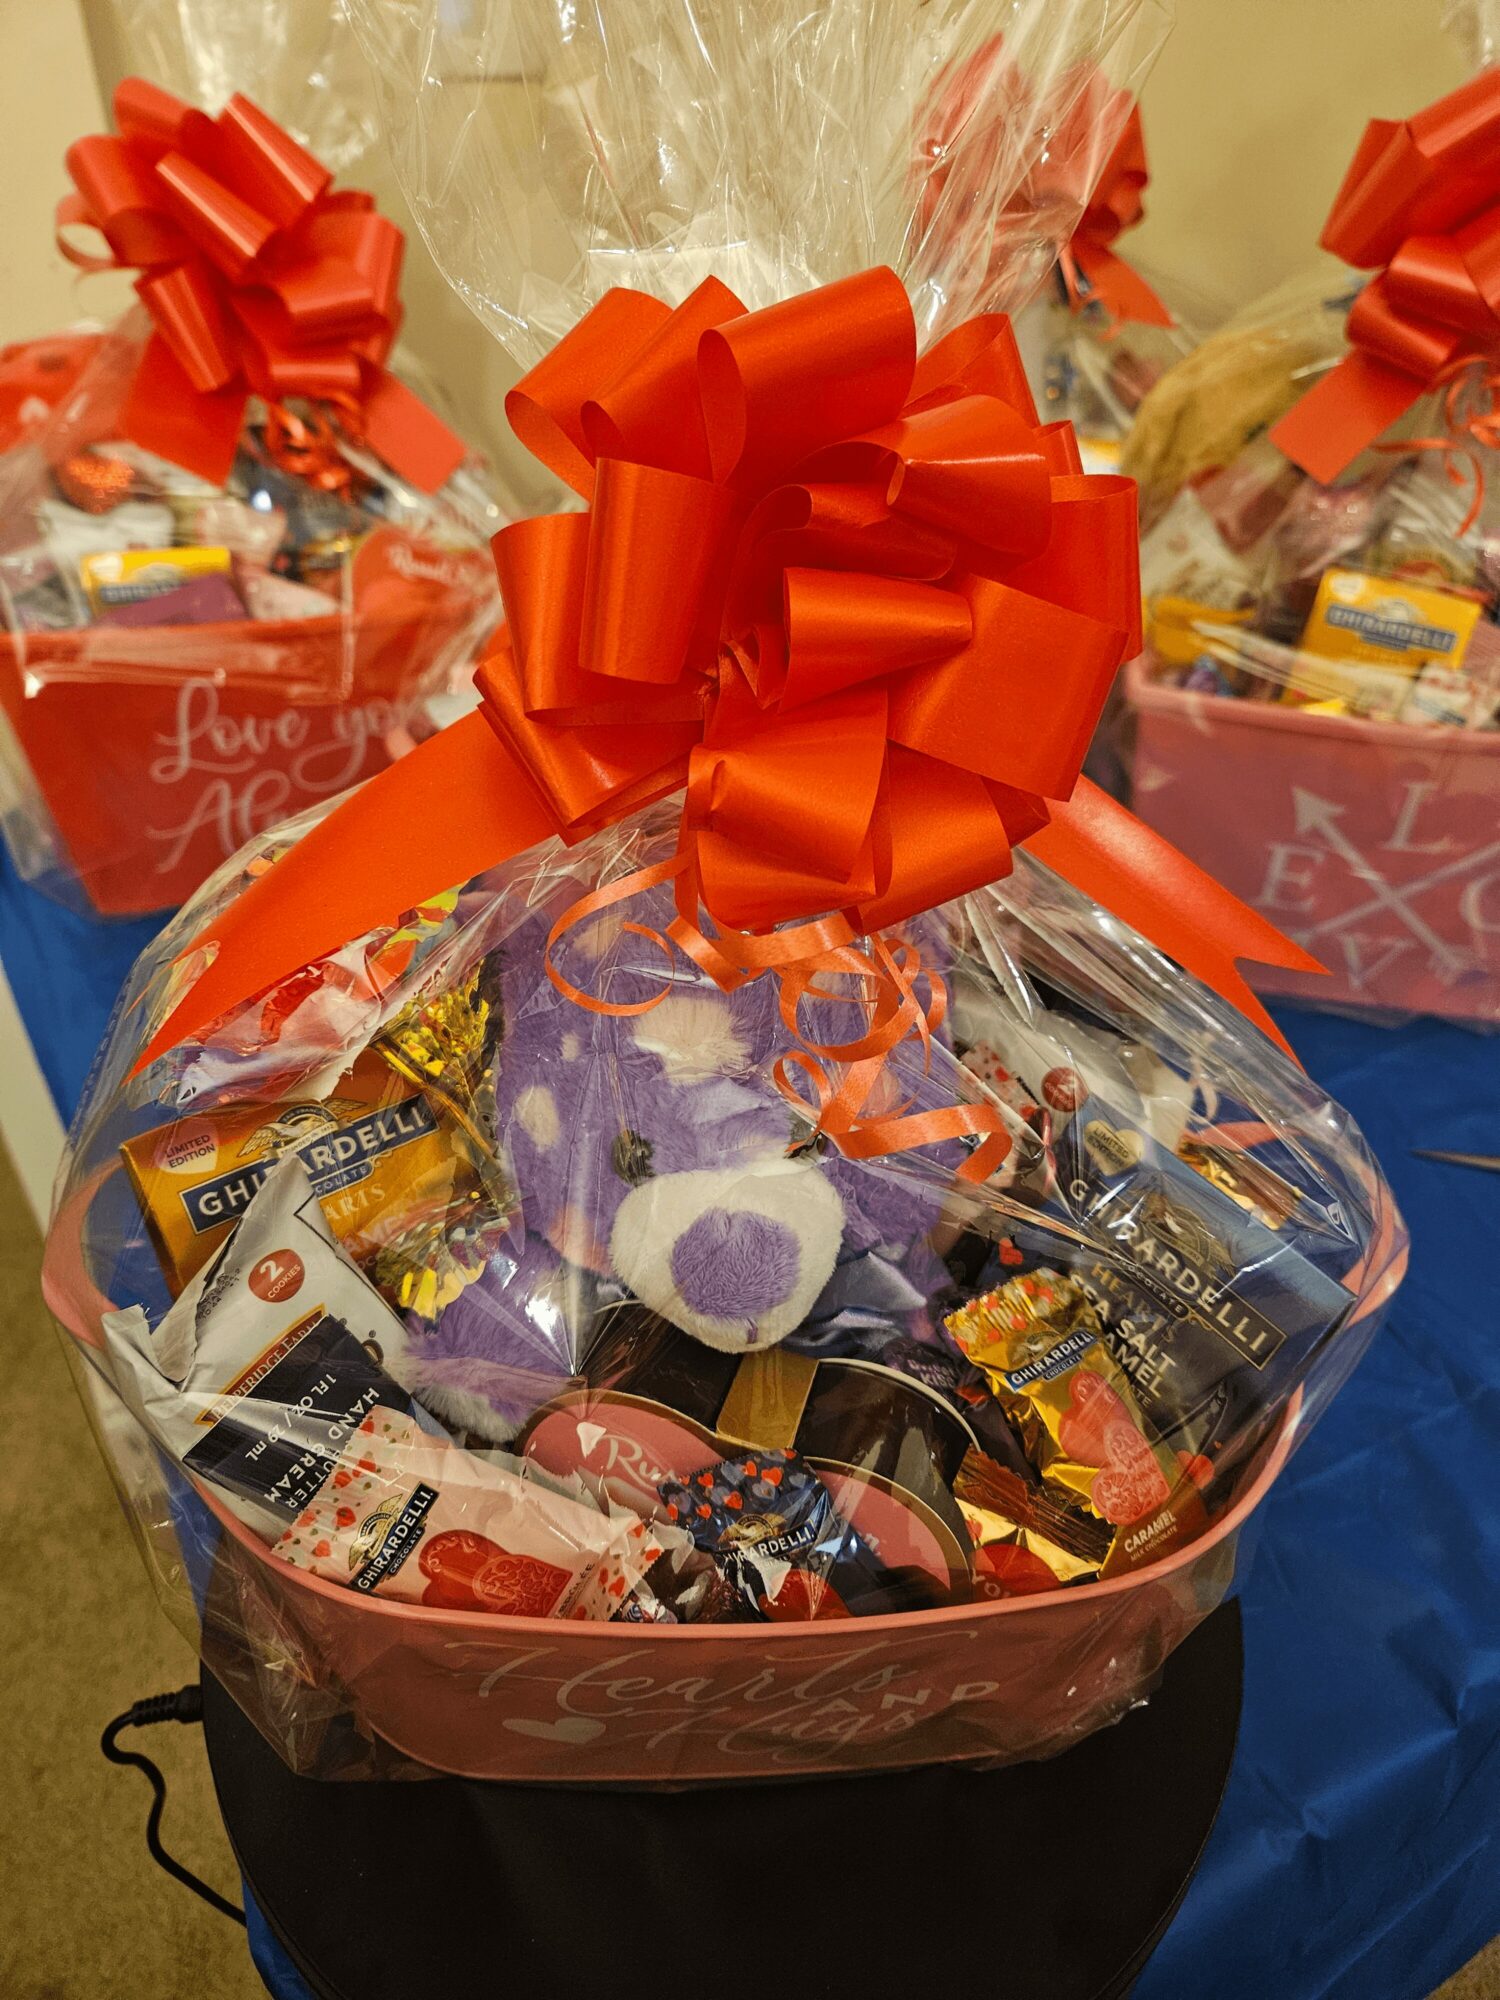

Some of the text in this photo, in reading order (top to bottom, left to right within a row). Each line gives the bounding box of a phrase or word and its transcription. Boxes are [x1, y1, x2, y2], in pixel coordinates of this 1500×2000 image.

[151, 677, 311, 783] Love
[165, 1134, 211, 1158] LIMITED
[168, 1143, 216, 1168] EDITION
[1093, 1126, 1130, 1159] LIMITED
[315, 1166, 368, 1194] COLATE
[322, 1182, 387, 1220] ARTS
[259, 1258, 285, 1283] 2
[267, 1263, 302, 1299] COOKIES
[1115, 1318, 1178, 1374] SALT
[263, 1387, 380, 1504] HAND CREAM
[267, 1423, 286, 1443] 29
[1124, 1509, 1177, 1553] CARAMEL
[389, 1529, 423, 1574] CHOCOLATE
[434, 1631, 978, 1718] Hearts
[811, 1680, 1000, 1717] AND
